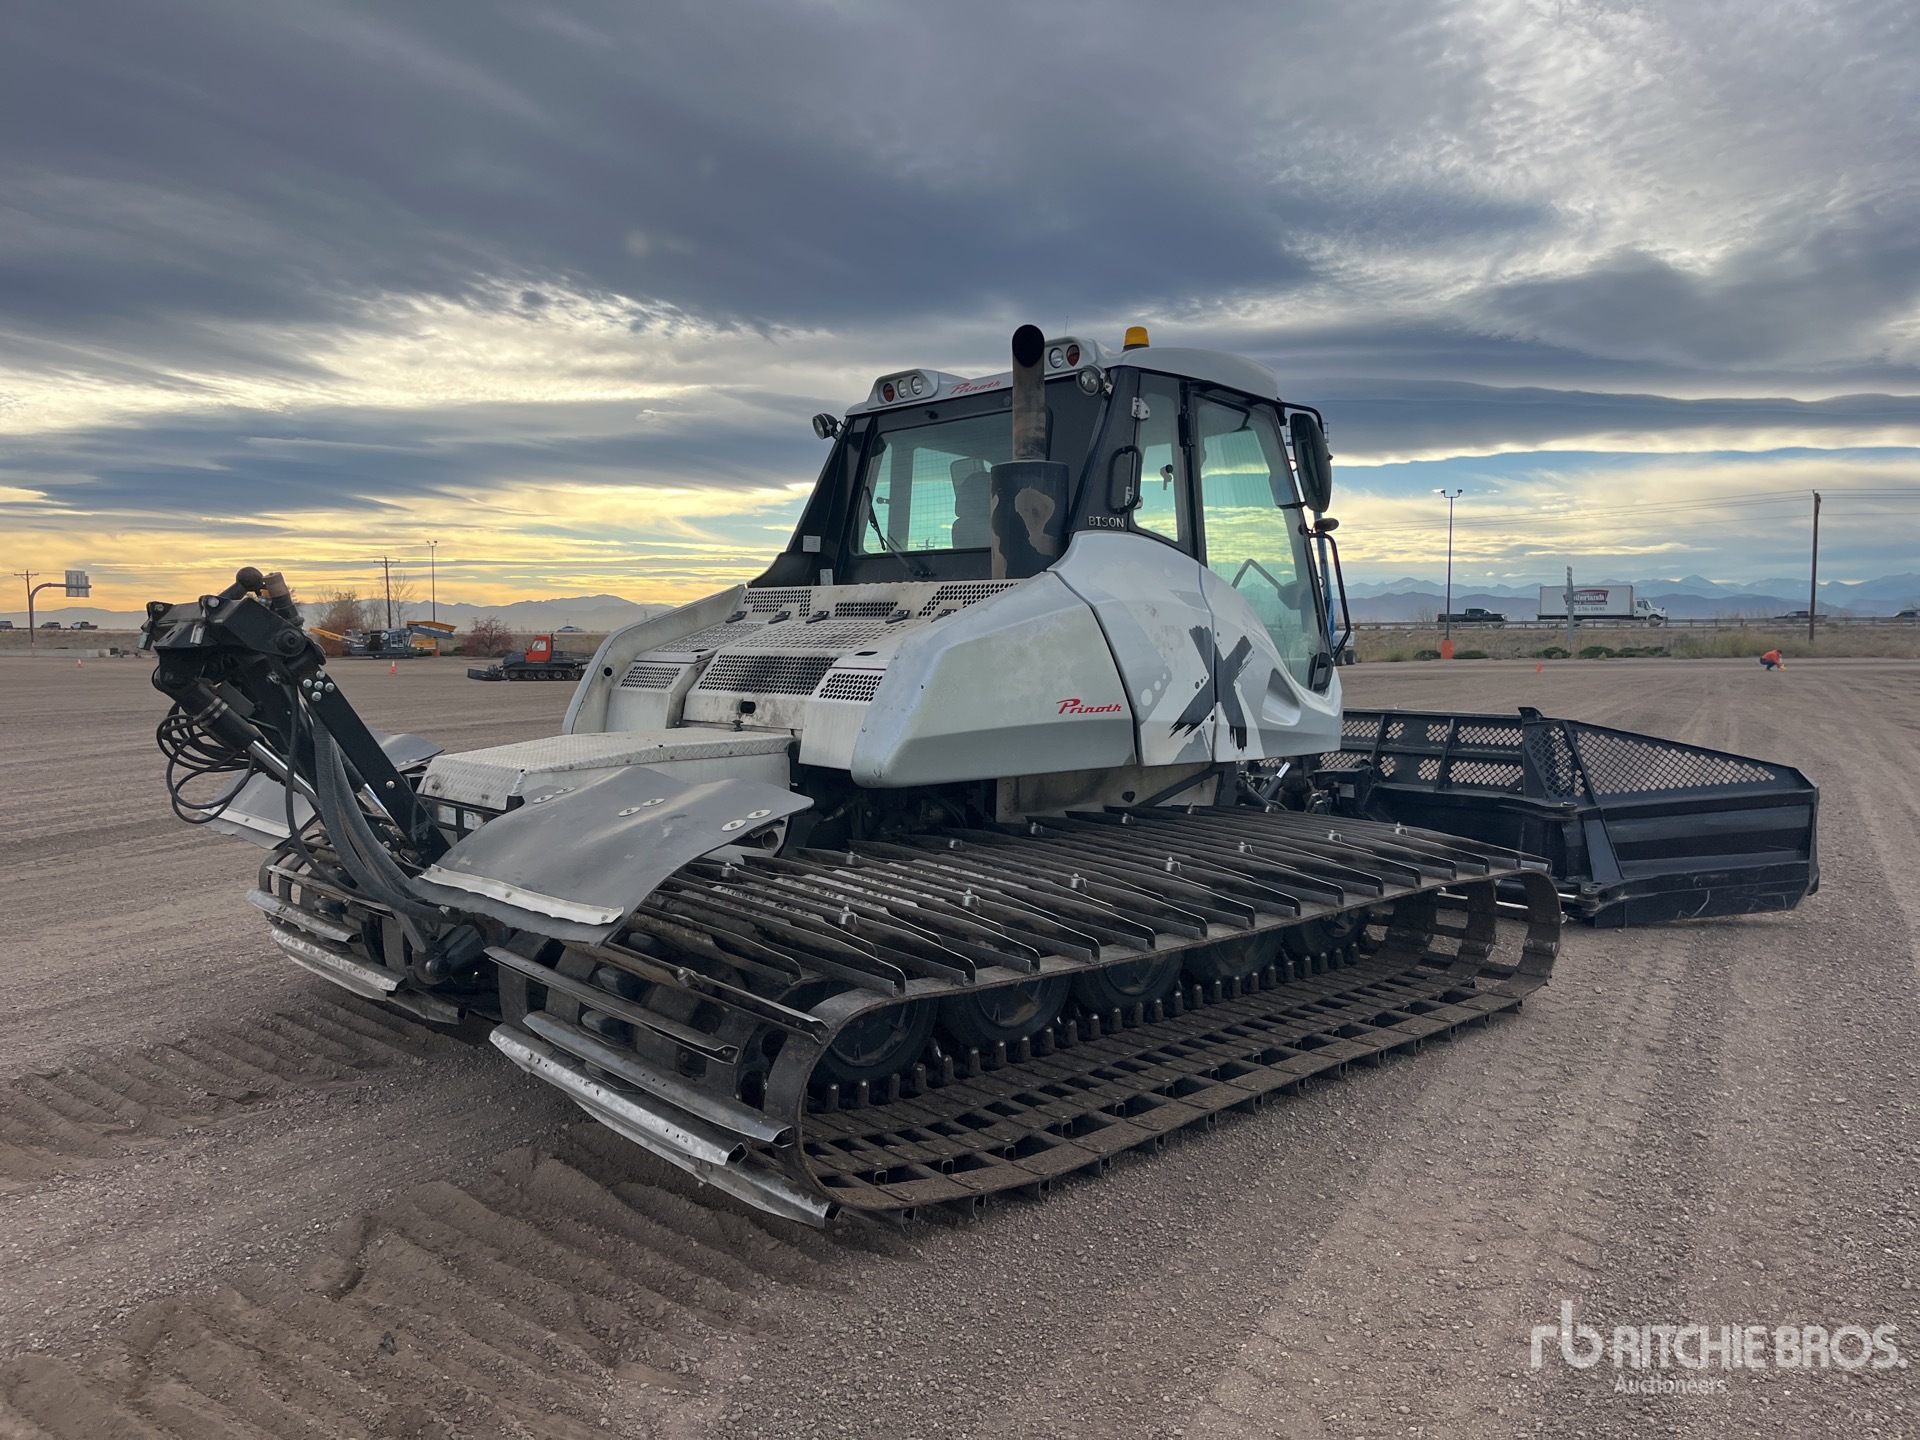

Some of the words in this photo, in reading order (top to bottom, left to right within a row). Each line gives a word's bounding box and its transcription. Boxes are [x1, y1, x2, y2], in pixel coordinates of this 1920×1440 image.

[951, 380, 1001, 395] Prinoth
[1088, 515, 1125, 528] BISON
[1056, 698, 1122, 714] Prinoth
